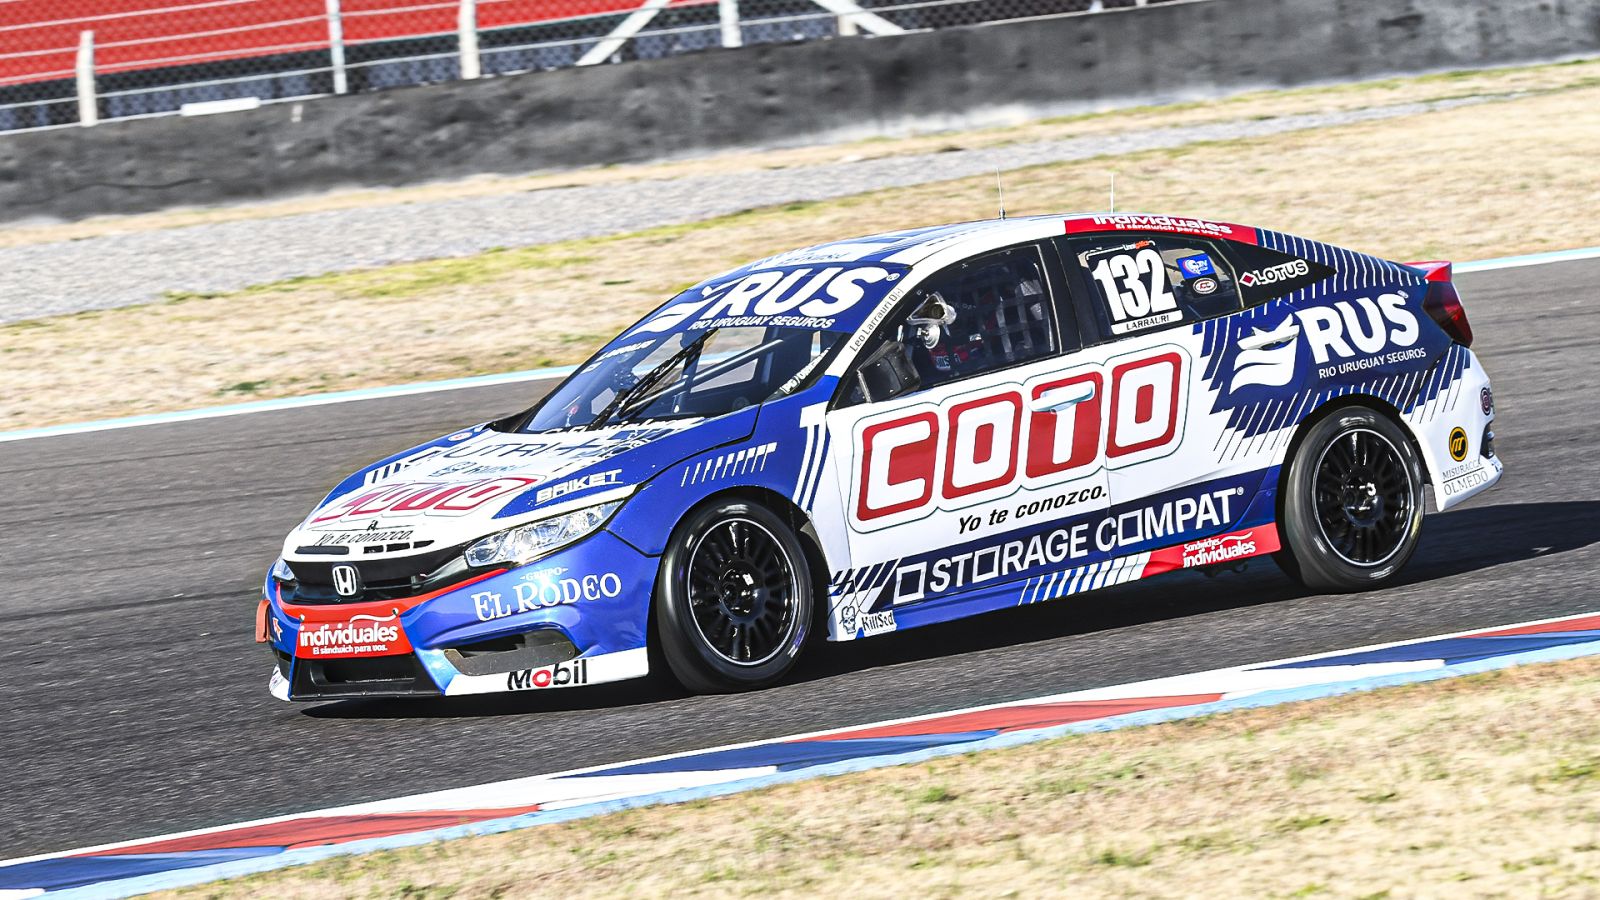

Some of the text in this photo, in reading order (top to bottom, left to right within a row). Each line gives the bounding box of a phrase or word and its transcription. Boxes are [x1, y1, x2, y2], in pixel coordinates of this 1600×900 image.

[1093, 215, 1233, 235] individuales
[1092, 249, 1177, 322] 132
[1255, 259, 1308, 285] LOTUS
[700, 267, 890, 319] RUS
[687, 315, 835, 331] RIO URUGUAY SEGUROS
[849, 336, 865, 353] Leo
[864, 300, 892, 337] Larrauri
[1126, 315, 1169, 330] LARRAURI
[1295, 293, 1419, 364] RUS
[1318, 347, 1426, 379] RIO URUGUAY SEGUROS
[857, 352, 1182, 522] COTO
[536, 469, 623, 504] BRIKET
[1443, 470, 1489, 496] OLMEDO
[959, 485, 1107, 534] Yo te conozco.
[331, 532, 350, 545] te
[1182, 540, 1256, 568] individuales
[513, 573, 622, 614] RODEO
[300, 622, 399, 647] individuales
[355, 645, 371, 654] para
[507, 659, 588, 690] Mobil
